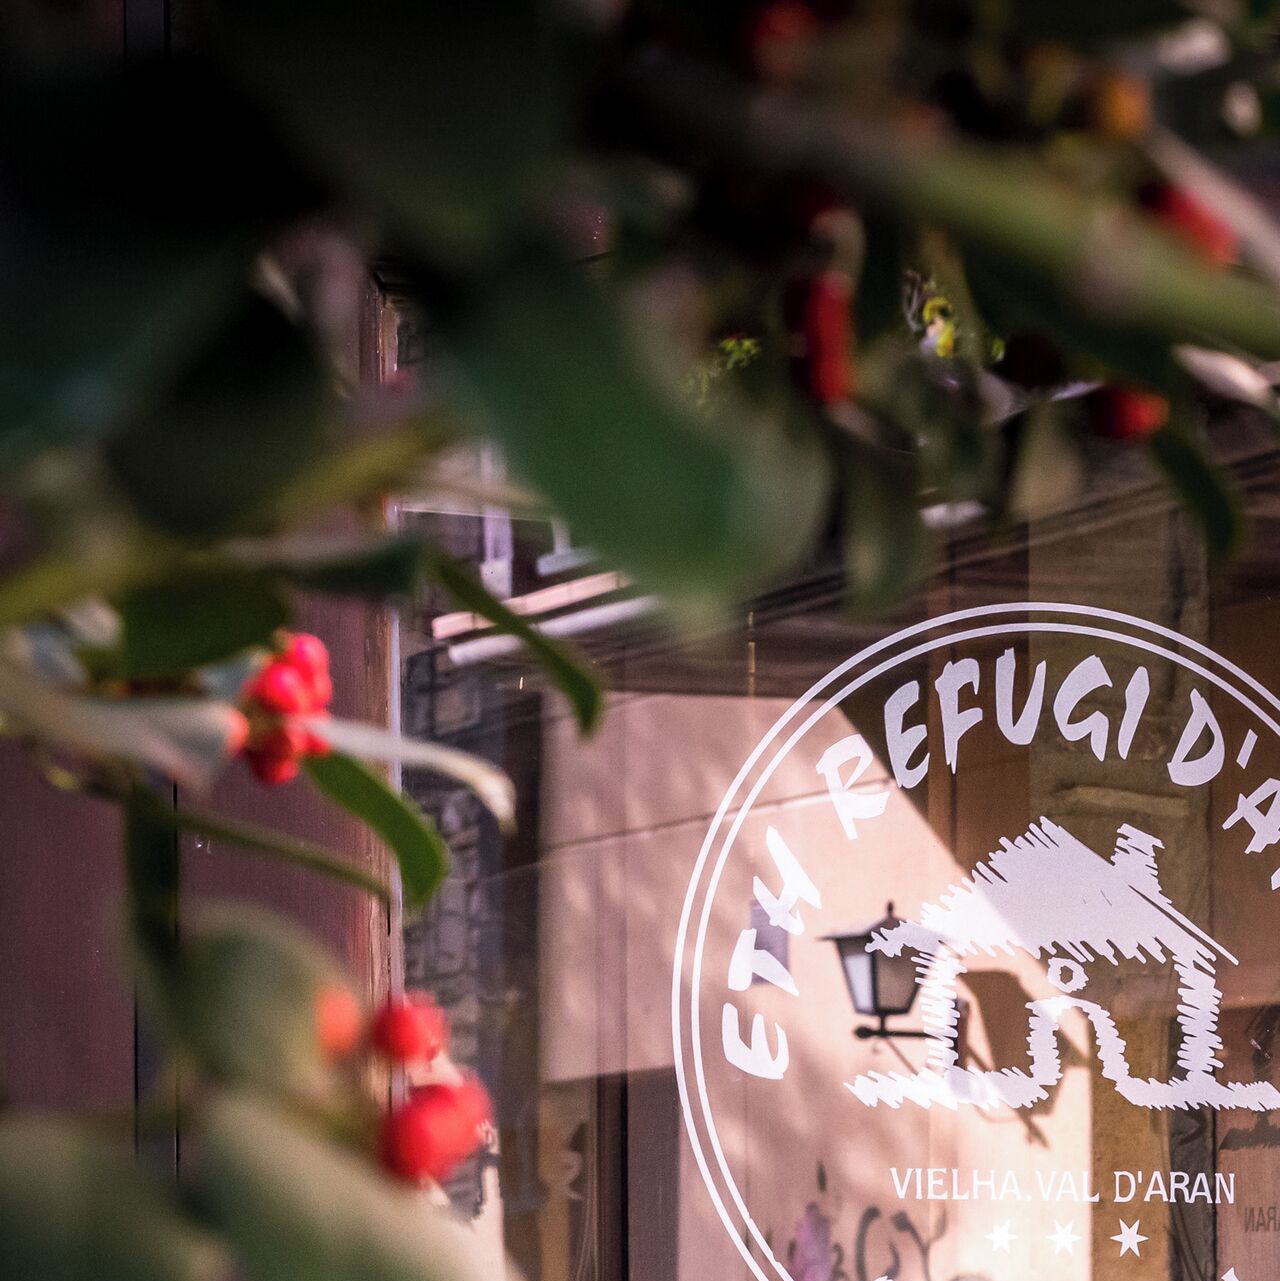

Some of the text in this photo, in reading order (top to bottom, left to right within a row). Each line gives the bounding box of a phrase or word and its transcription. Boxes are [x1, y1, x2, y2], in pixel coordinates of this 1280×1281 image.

[721, 824, 822, 1080] ETH
[815, 647, 1150, 840] REFUGI
[1112, 1170, 1236, 1204] D'ARAN
